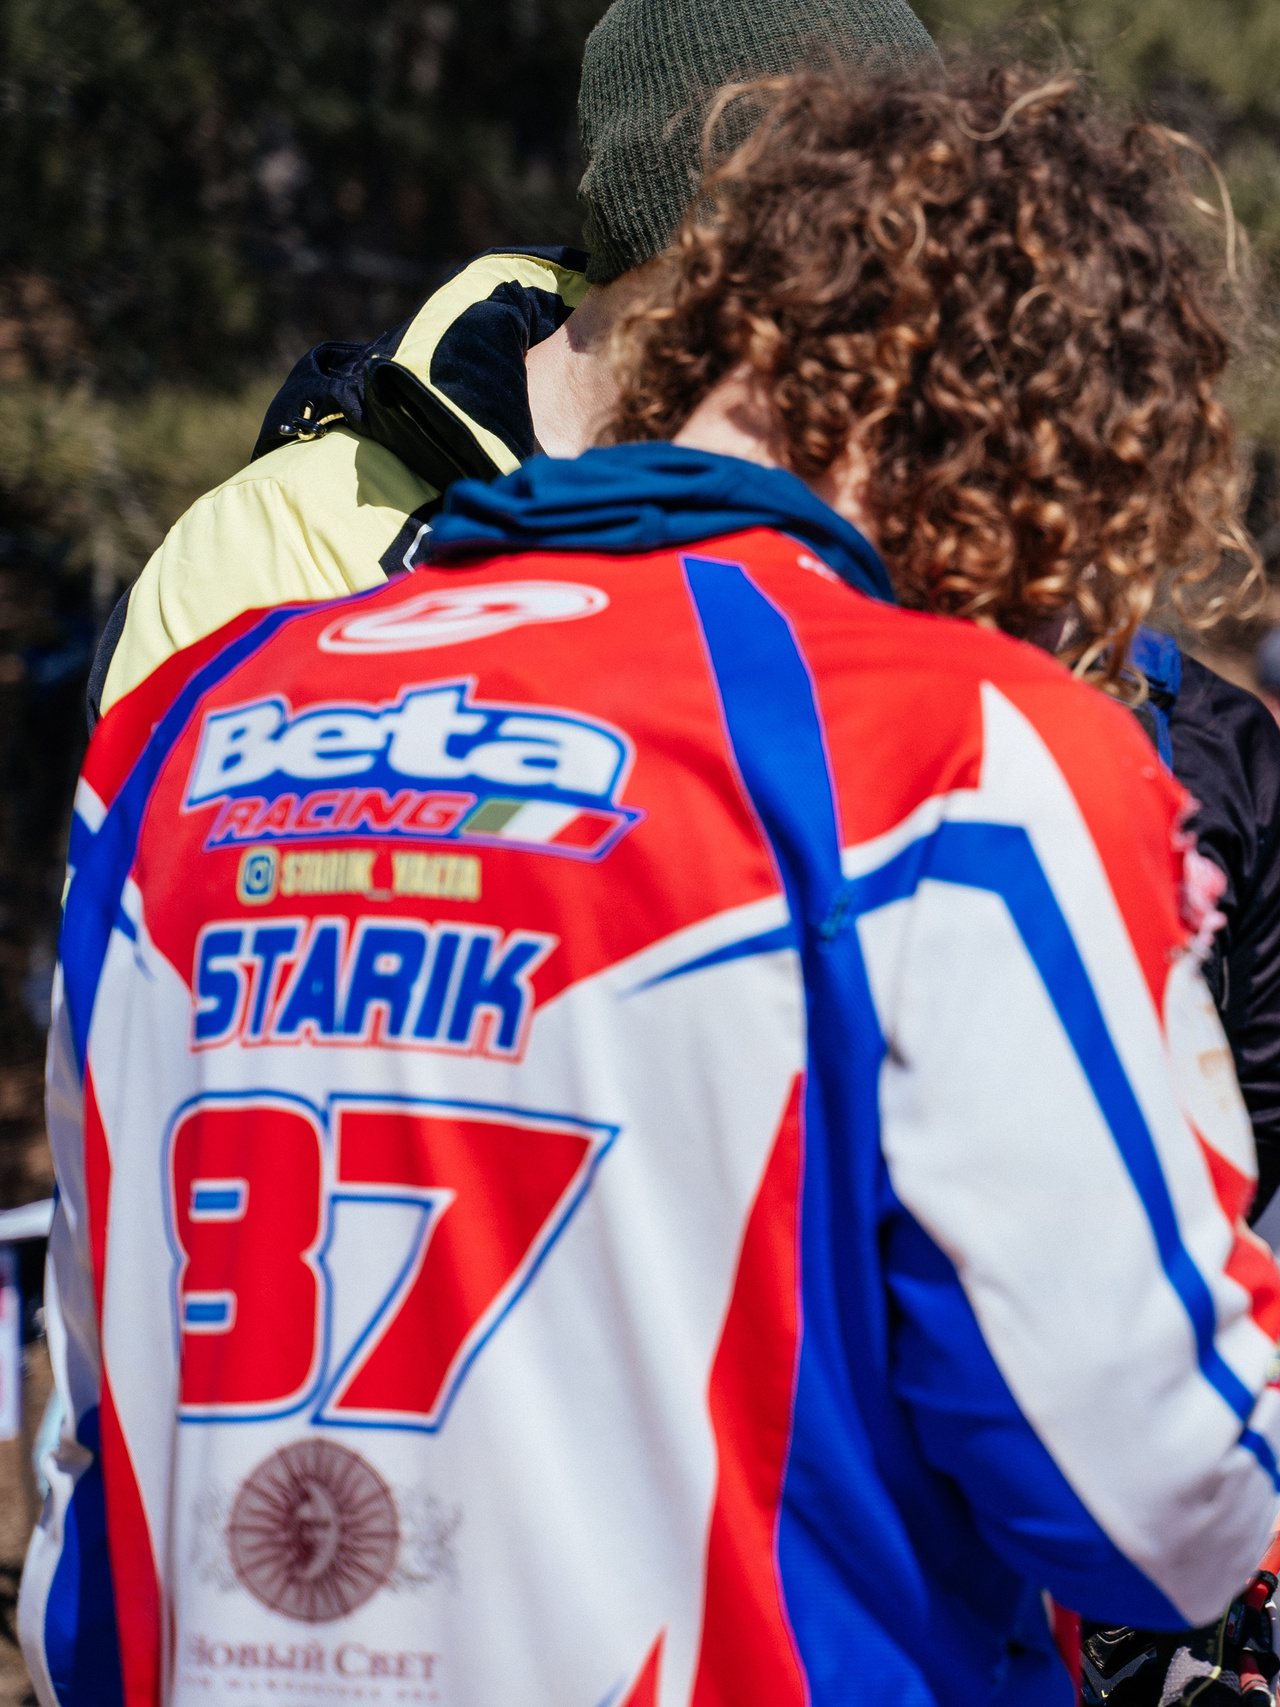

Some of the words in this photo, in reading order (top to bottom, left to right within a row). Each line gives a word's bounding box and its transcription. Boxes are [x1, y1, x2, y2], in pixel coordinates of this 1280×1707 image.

[184, 682, 634, 810] Beta
[213, 789, 475, 837] RACING
[191, 919, 558, 1062] STARIK
[160, 1089, 621, 1434] 87
